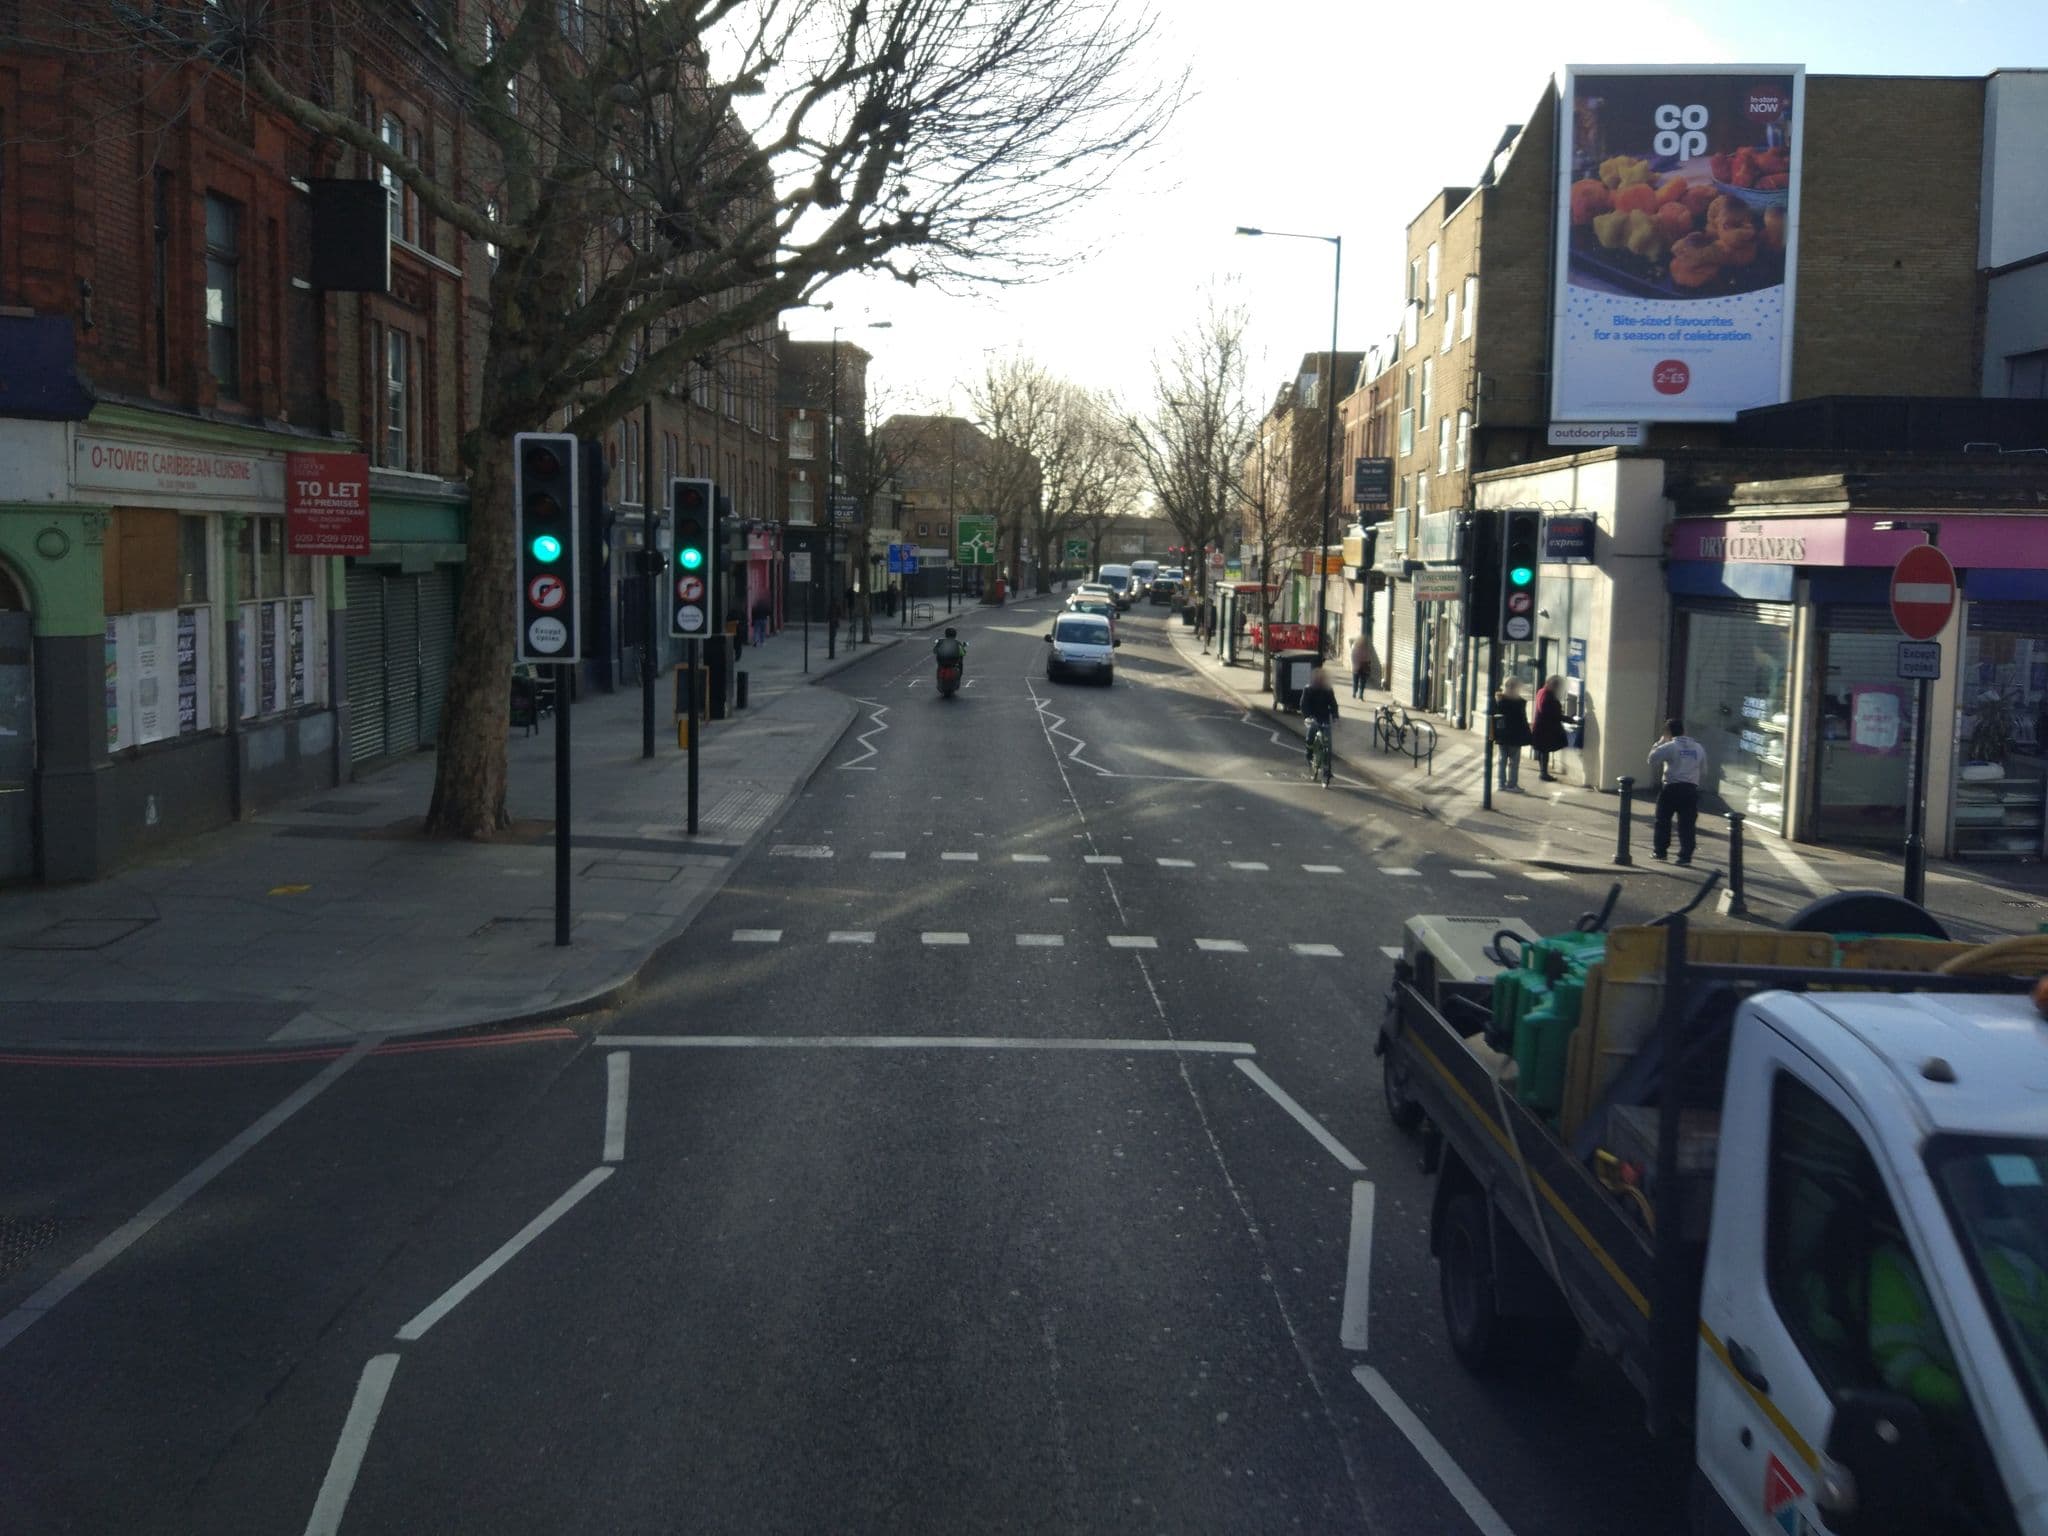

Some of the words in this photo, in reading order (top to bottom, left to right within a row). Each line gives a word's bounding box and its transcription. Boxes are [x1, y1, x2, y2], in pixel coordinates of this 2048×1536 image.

[1750, 104, 1778, 113] NOW
[1613, 315, 1672, 327] Bite-sized
[1675, 315, 1733, 327] favourites
[1594, 329, 1610, 340] for
[1613, 332, 1620, 340] a
[1622, 331, 1665, 340] season
[1668, 330, 1681, 340] of
[1683, 330, 1752, 341] celebration
[1555, 427, 1626, 440] outdoorplus
[92, 446, 148, 472] O-TOWER
[152, 453, 211, 478] CARIBBEAN
[214, 458, 251, 480] CUISINE
[296, 480, 322, 497] TO
[328, 481, 362, 498] LET
[314, 498, 360, 508] PREMISES
[1549, 539, 1585, 548] express
[1730, 537, 1806, 561] CLEANERS
[1904, 648, 1936, 660] Except
